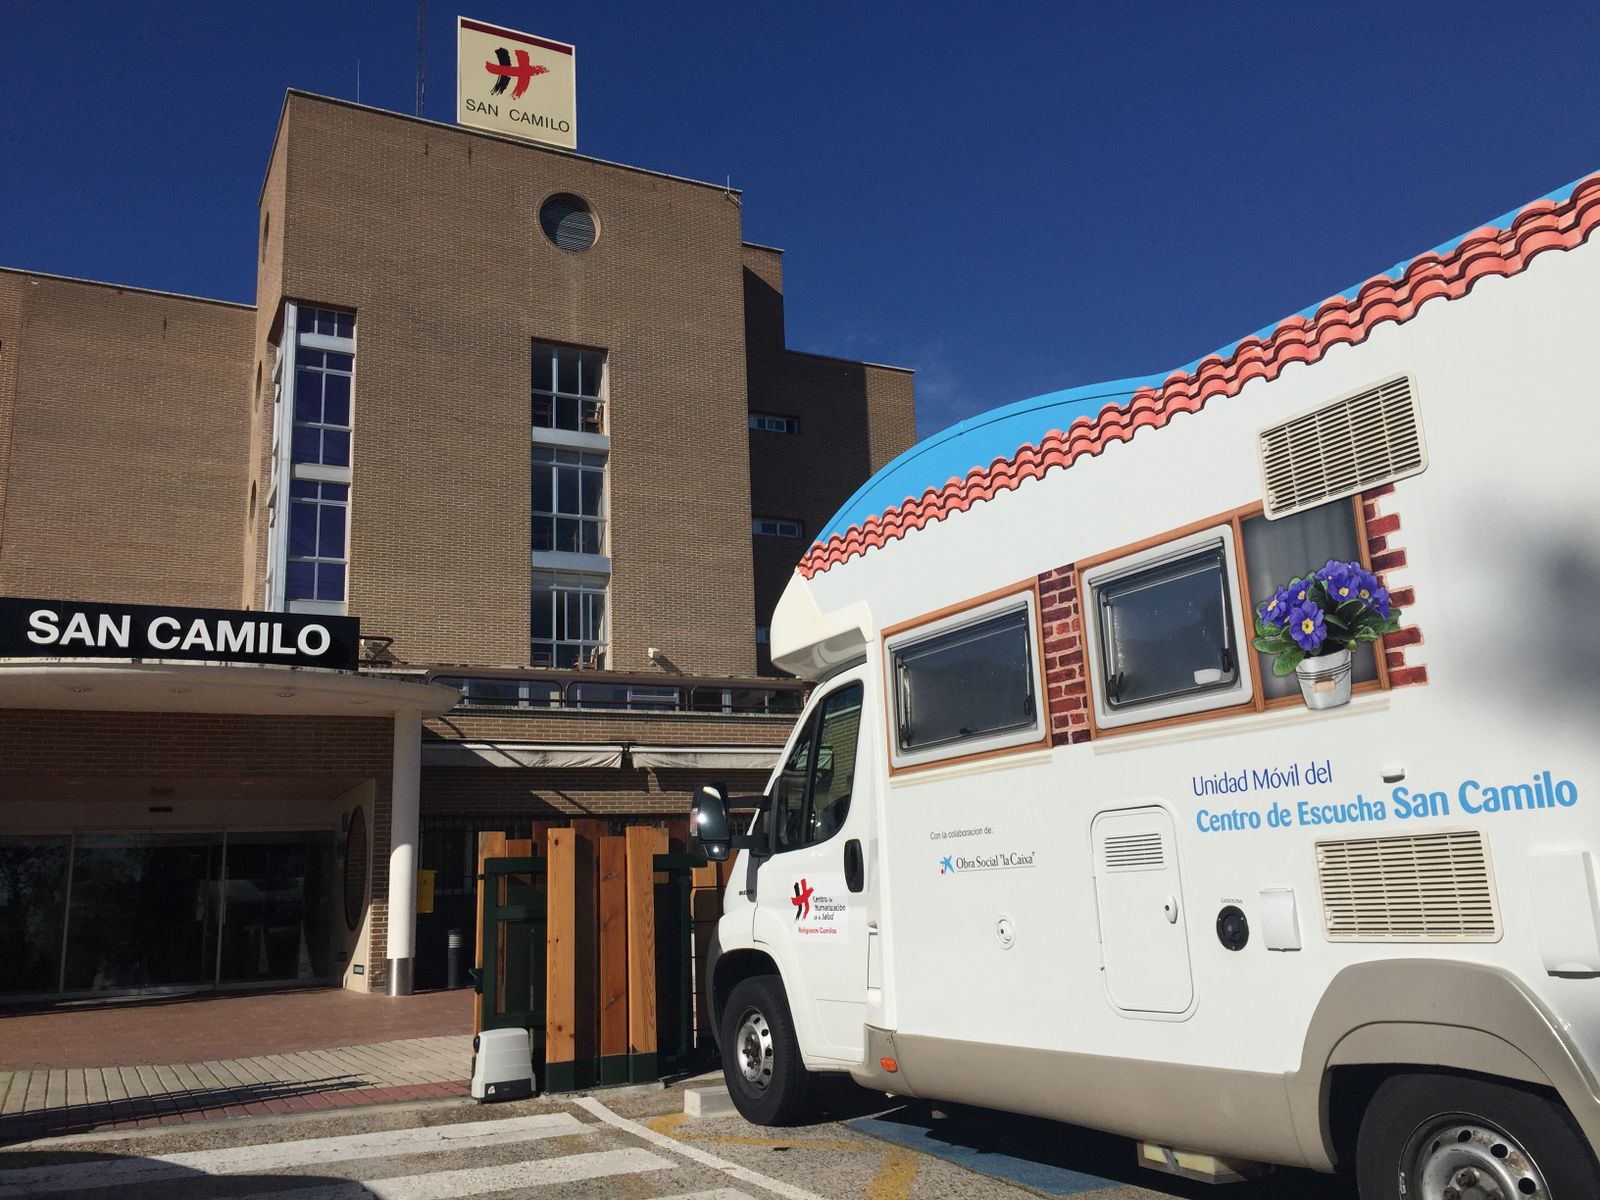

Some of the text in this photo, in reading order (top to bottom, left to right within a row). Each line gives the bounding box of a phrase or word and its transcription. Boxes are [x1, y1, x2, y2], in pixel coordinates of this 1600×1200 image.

[466, 98, 570, 133] SAN CAMILO
[27, 609, 331, 656] SAN CAMILO
[1192, 760, 1333, 796] Unidad Móvil del
[1196, 771, 1578, 833] Centro de Escucha San Camilo
[930, 831, 941, 840] Con
[956, 858, 975, 869] Obra
[976, 855, 998, 867] Social
